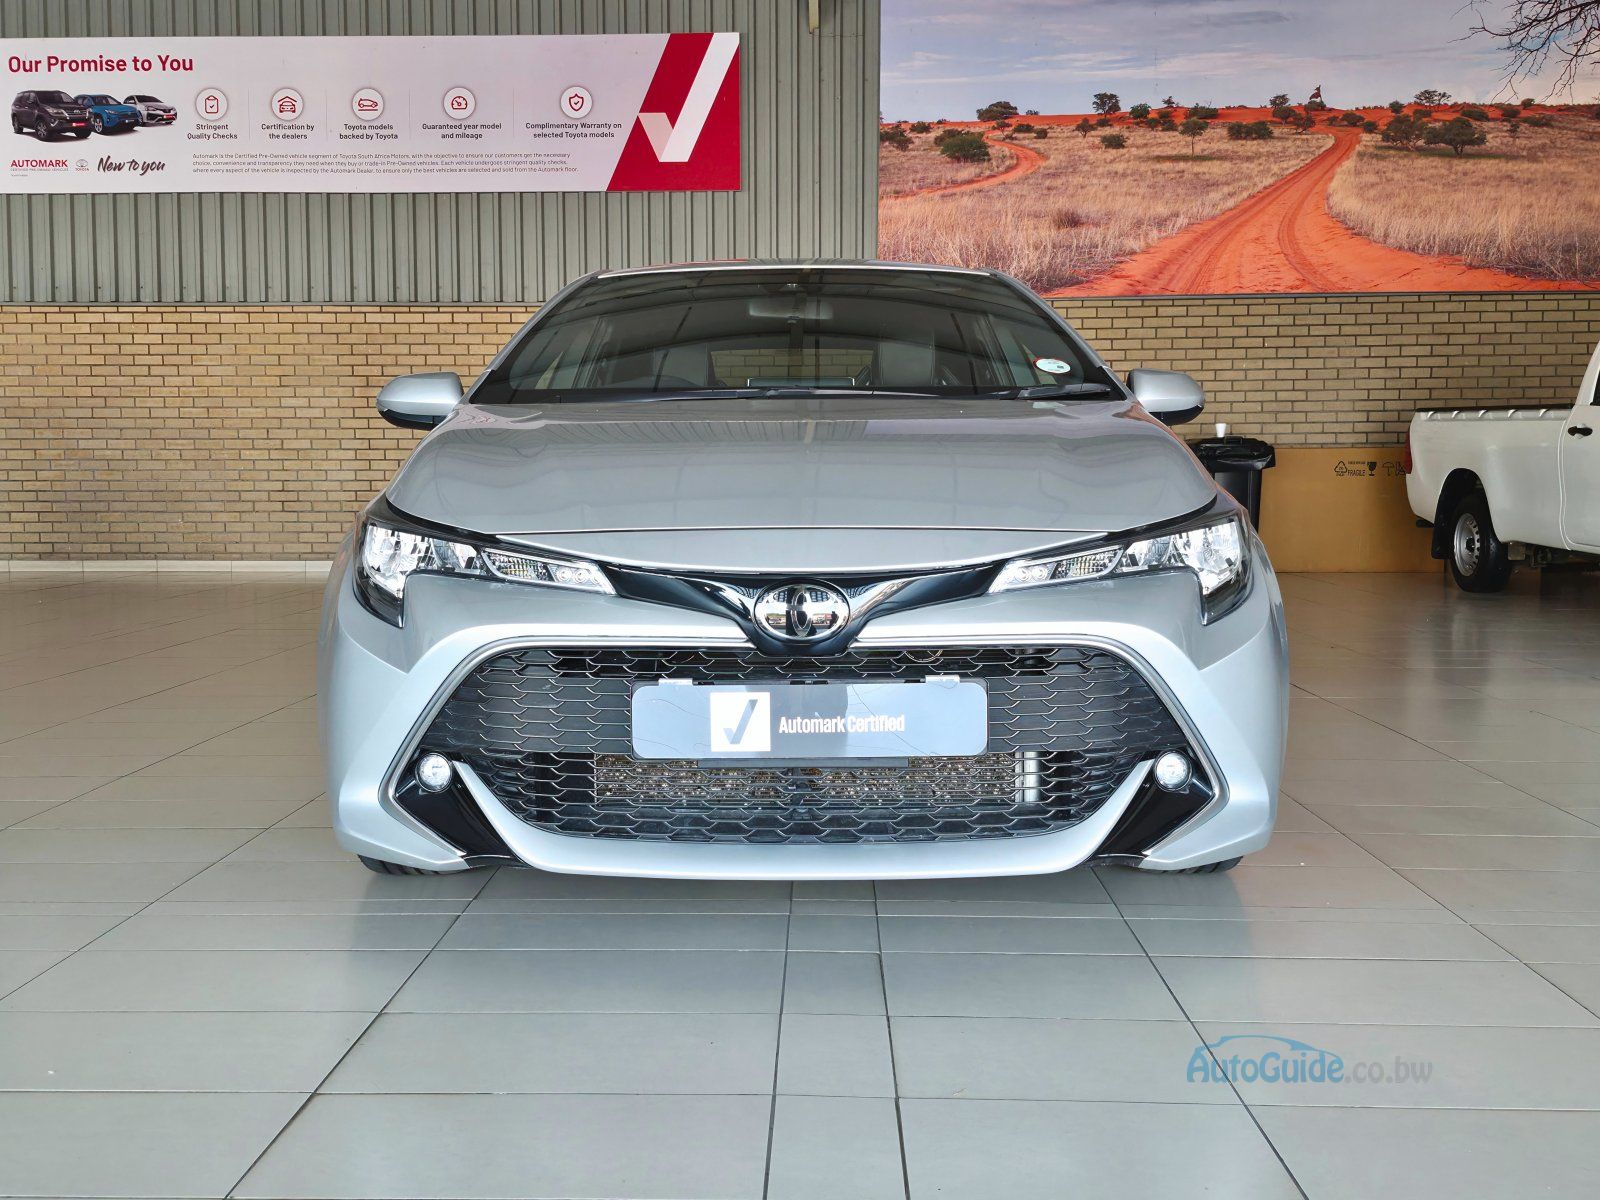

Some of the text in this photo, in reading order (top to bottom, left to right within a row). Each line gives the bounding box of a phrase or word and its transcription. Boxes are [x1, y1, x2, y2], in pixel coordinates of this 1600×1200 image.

[8, 54, 193, 73] Our Promise to You
[195, 123, 229, 131] Stringent
[306, 123, 315, 132] by
[343, 123, 394, 132] Toyota models
[463, 123, 479, 131] year
[480, 122, 502, 130] model
[525, 122, 579, 131] Complimentary
[580, 122, 612, 131] Warranty
[187, 133, 211, 141] Quality
[365, 133, 374, 141] by
[375, 132, 399, 141] Toyota
[455, 132, 483, 140] mileage
[564, 131, 588, 140] Toyota
[10, 159, 68, 168] AUTOMARK
[97, 155, 165, 177] New to you
[779, 715, 905, 733] Automark Certified
